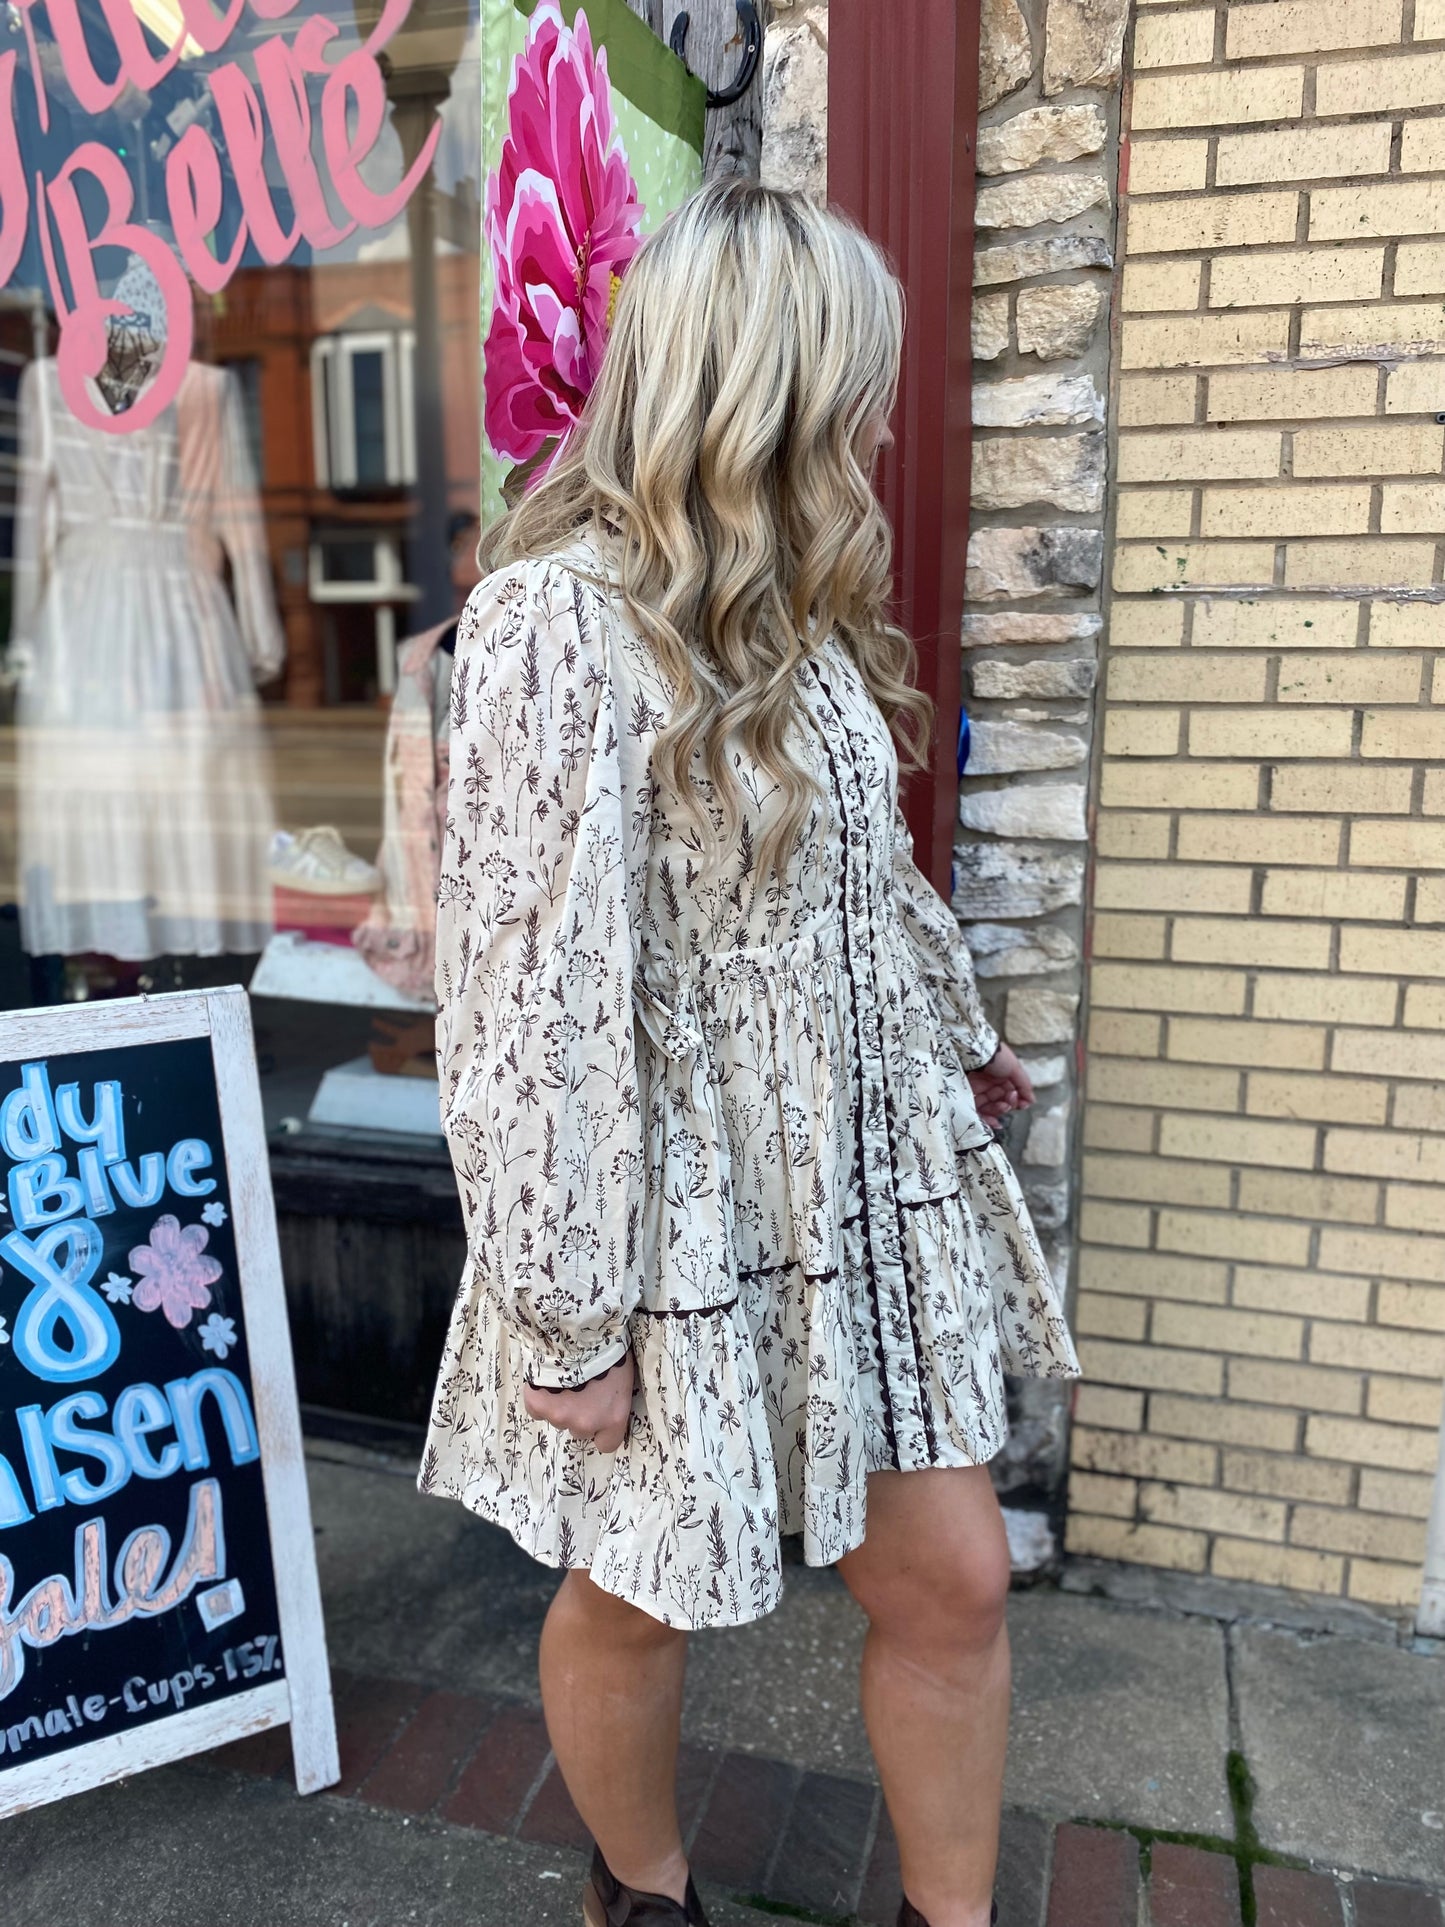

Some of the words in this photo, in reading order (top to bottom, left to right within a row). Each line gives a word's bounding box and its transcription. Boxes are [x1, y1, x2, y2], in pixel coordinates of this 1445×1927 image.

[36, 14, 443, 434] Belle
[8, 1138, 217, 1230] Blue
[0, 1367, 260, 1529] isen
